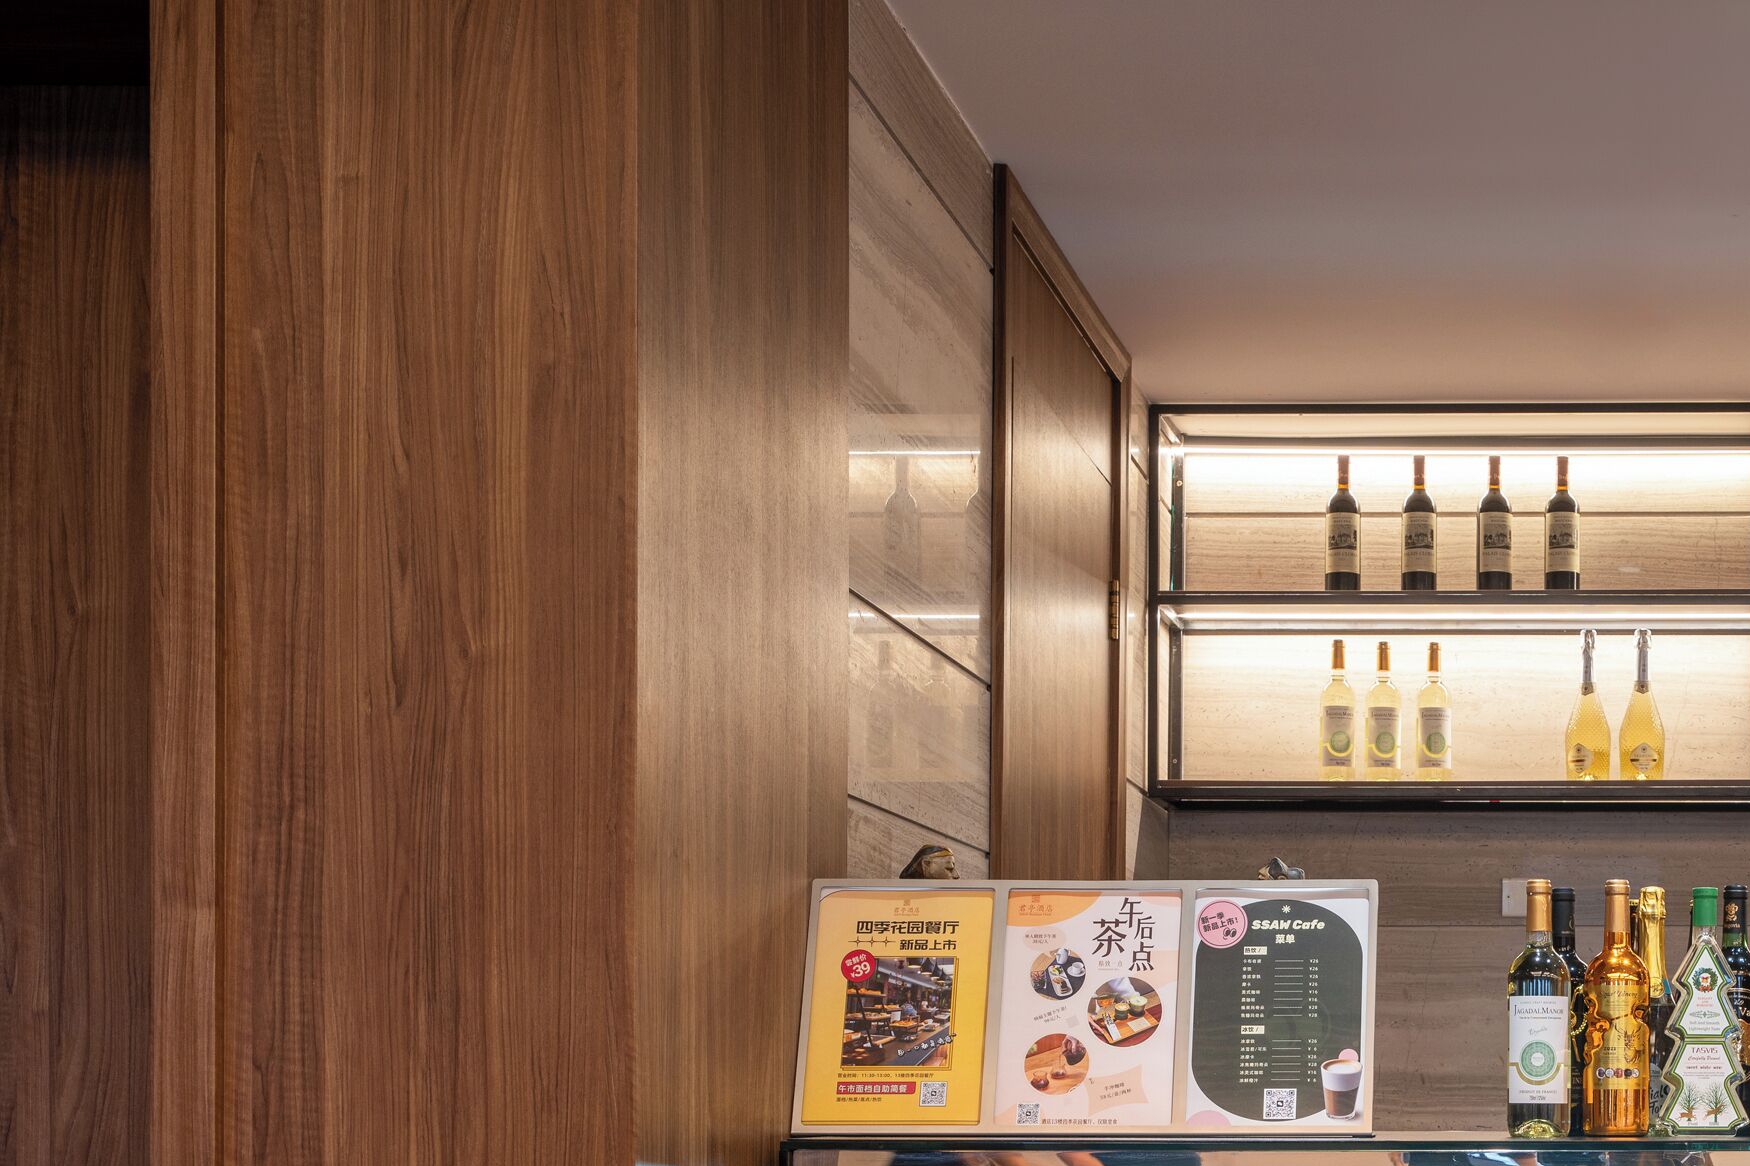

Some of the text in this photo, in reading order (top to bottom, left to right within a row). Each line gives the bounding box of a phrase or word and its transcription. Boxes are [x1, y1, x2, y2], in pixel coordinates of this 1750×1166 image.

[1201, 912, 1224, 925] 新一季
[856, 920, 959, 934] 四季花园餐厅
[1252, 919, 1325, 930] SSAW Cafe
[900, 939, 956, 950] 新品上市
[1275, 934, 1295, 944] 菜单
[838, 1084, 908, 1093] 午市面档自助简餐
